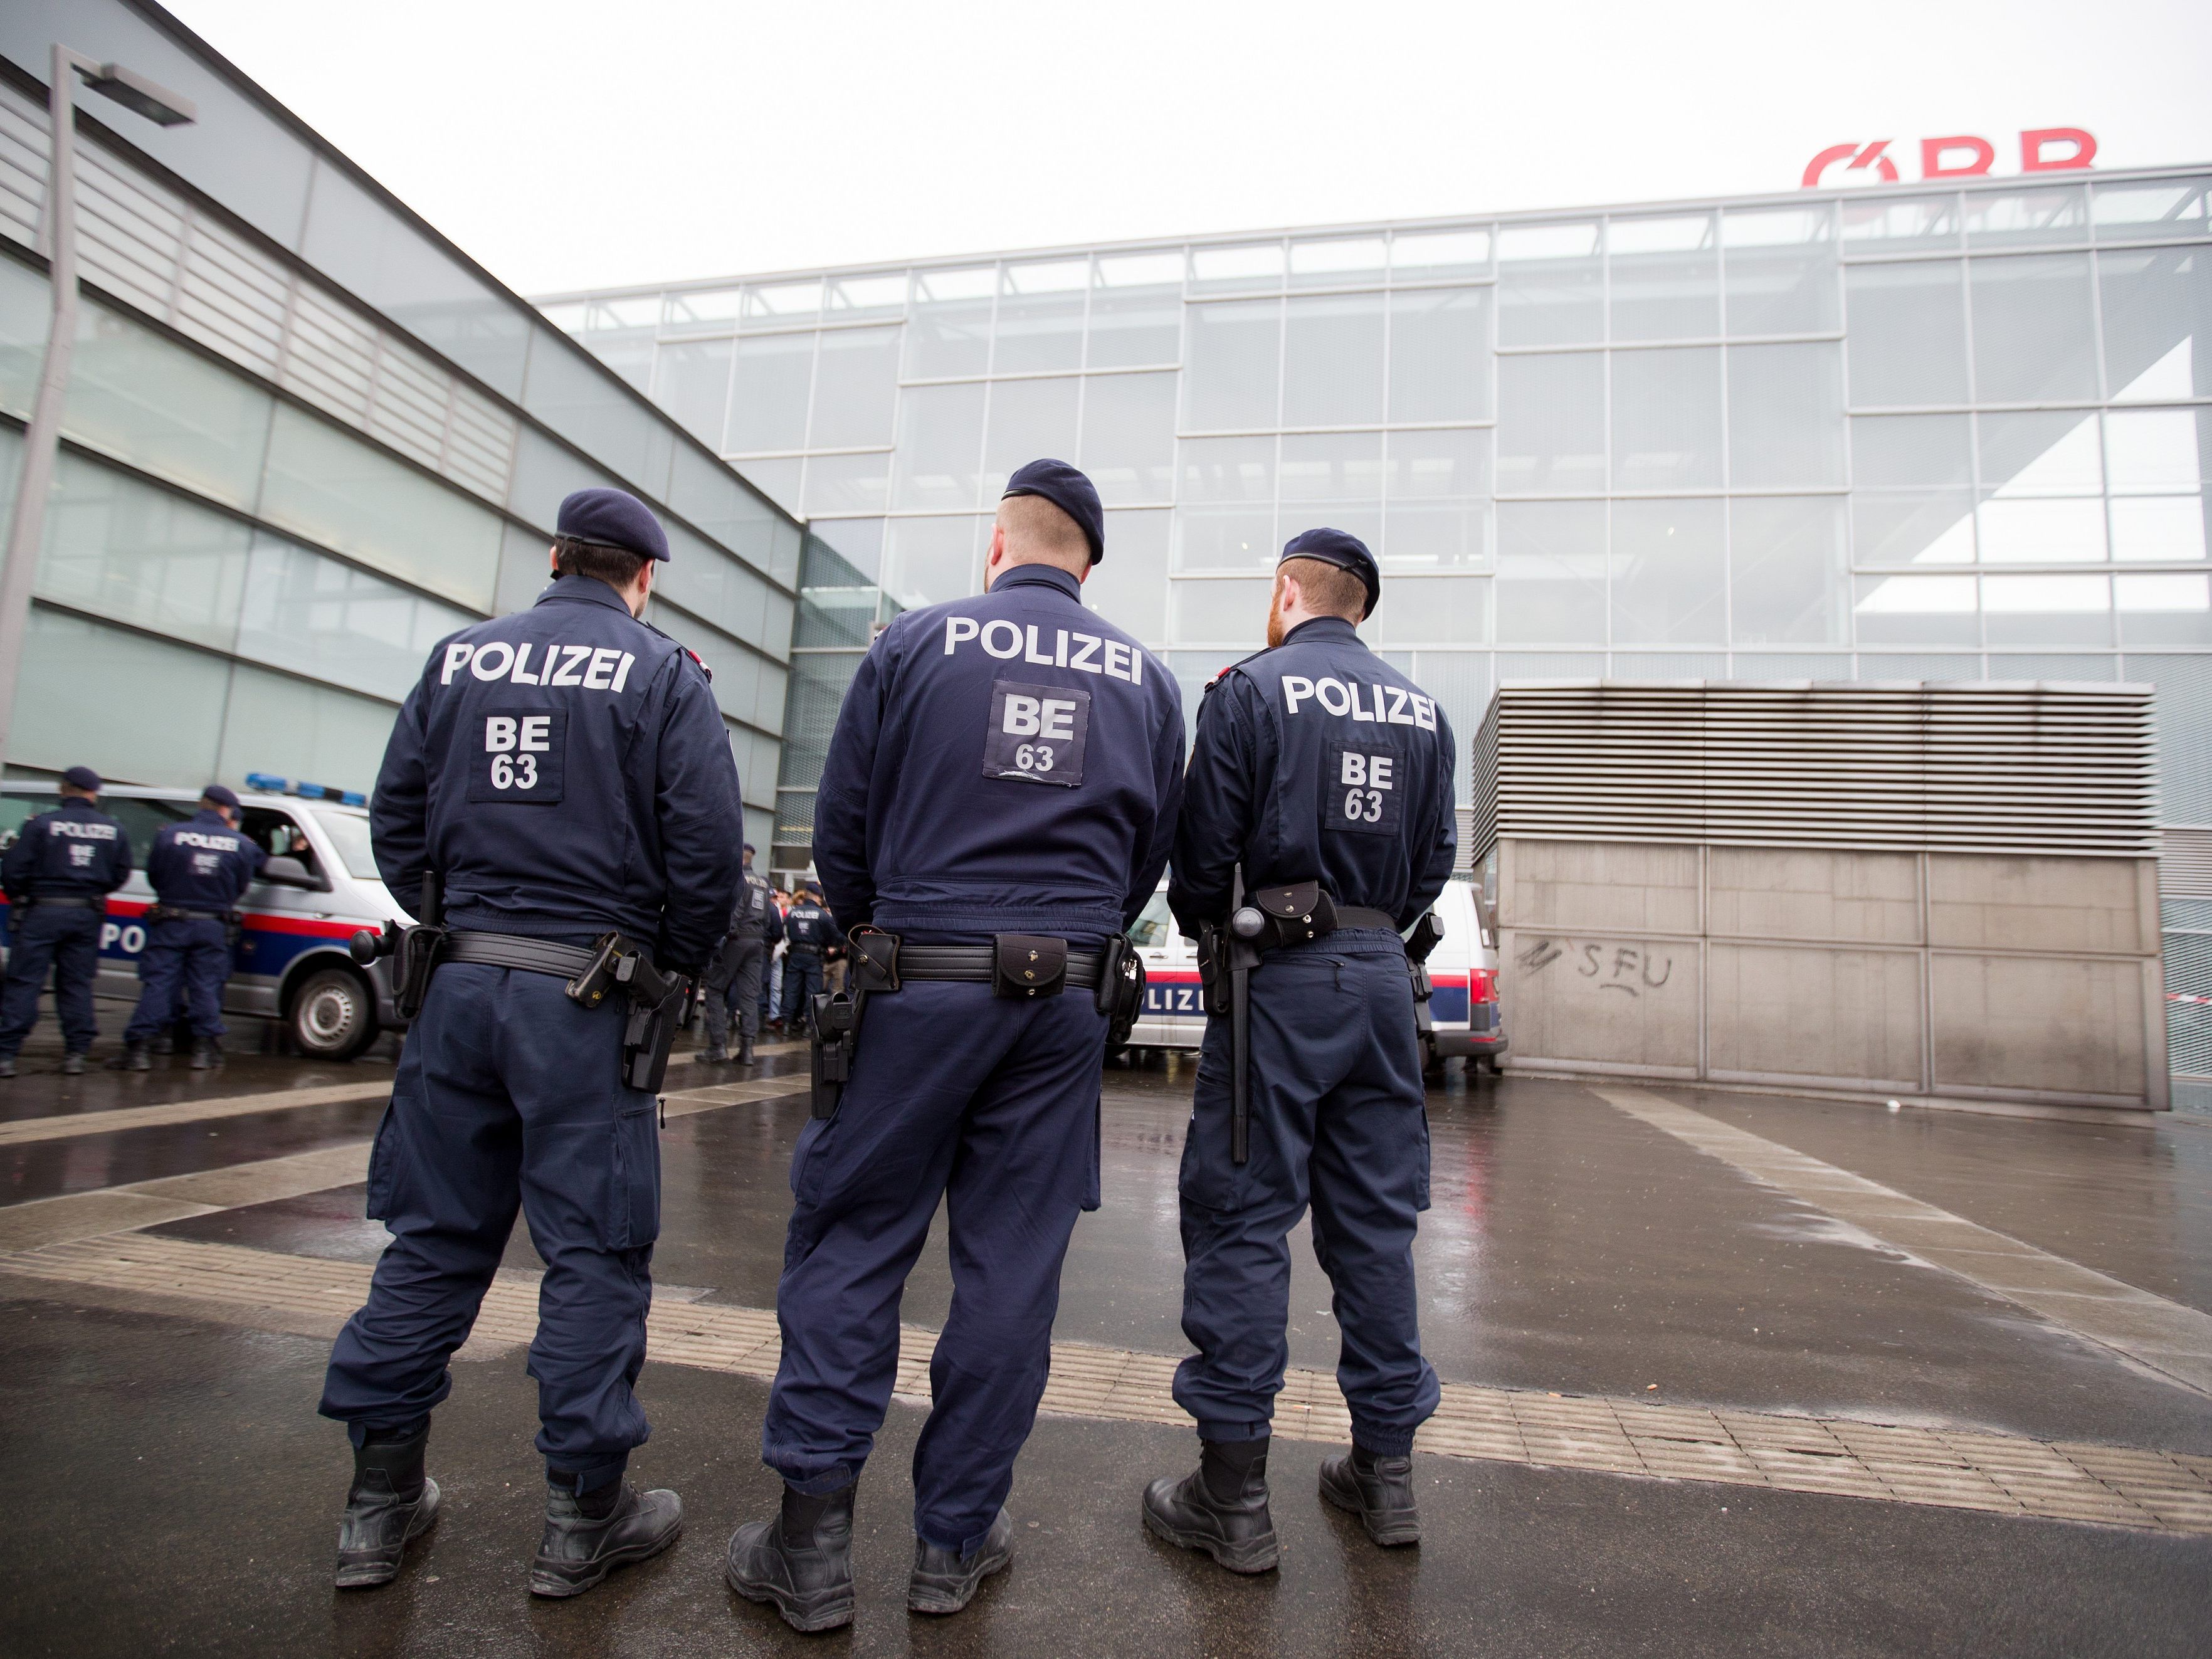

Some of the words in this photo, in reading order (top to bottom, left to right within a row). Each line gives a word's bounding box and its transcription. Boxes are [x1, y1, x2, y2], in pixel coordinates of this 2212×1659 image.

[440, 641, 635, 693] POLIZEI
[944, 617, 1142, 685] POLIZEI
[485, 716, 550, 752] BE
[1003, 693, 1076, 740] BE
[490, 754, 538, 789] 63
[1015, 744, 1054, 772] 63
[1341, 751, 1393, 790] BE
[1344, 787, 1382, 822] 63
